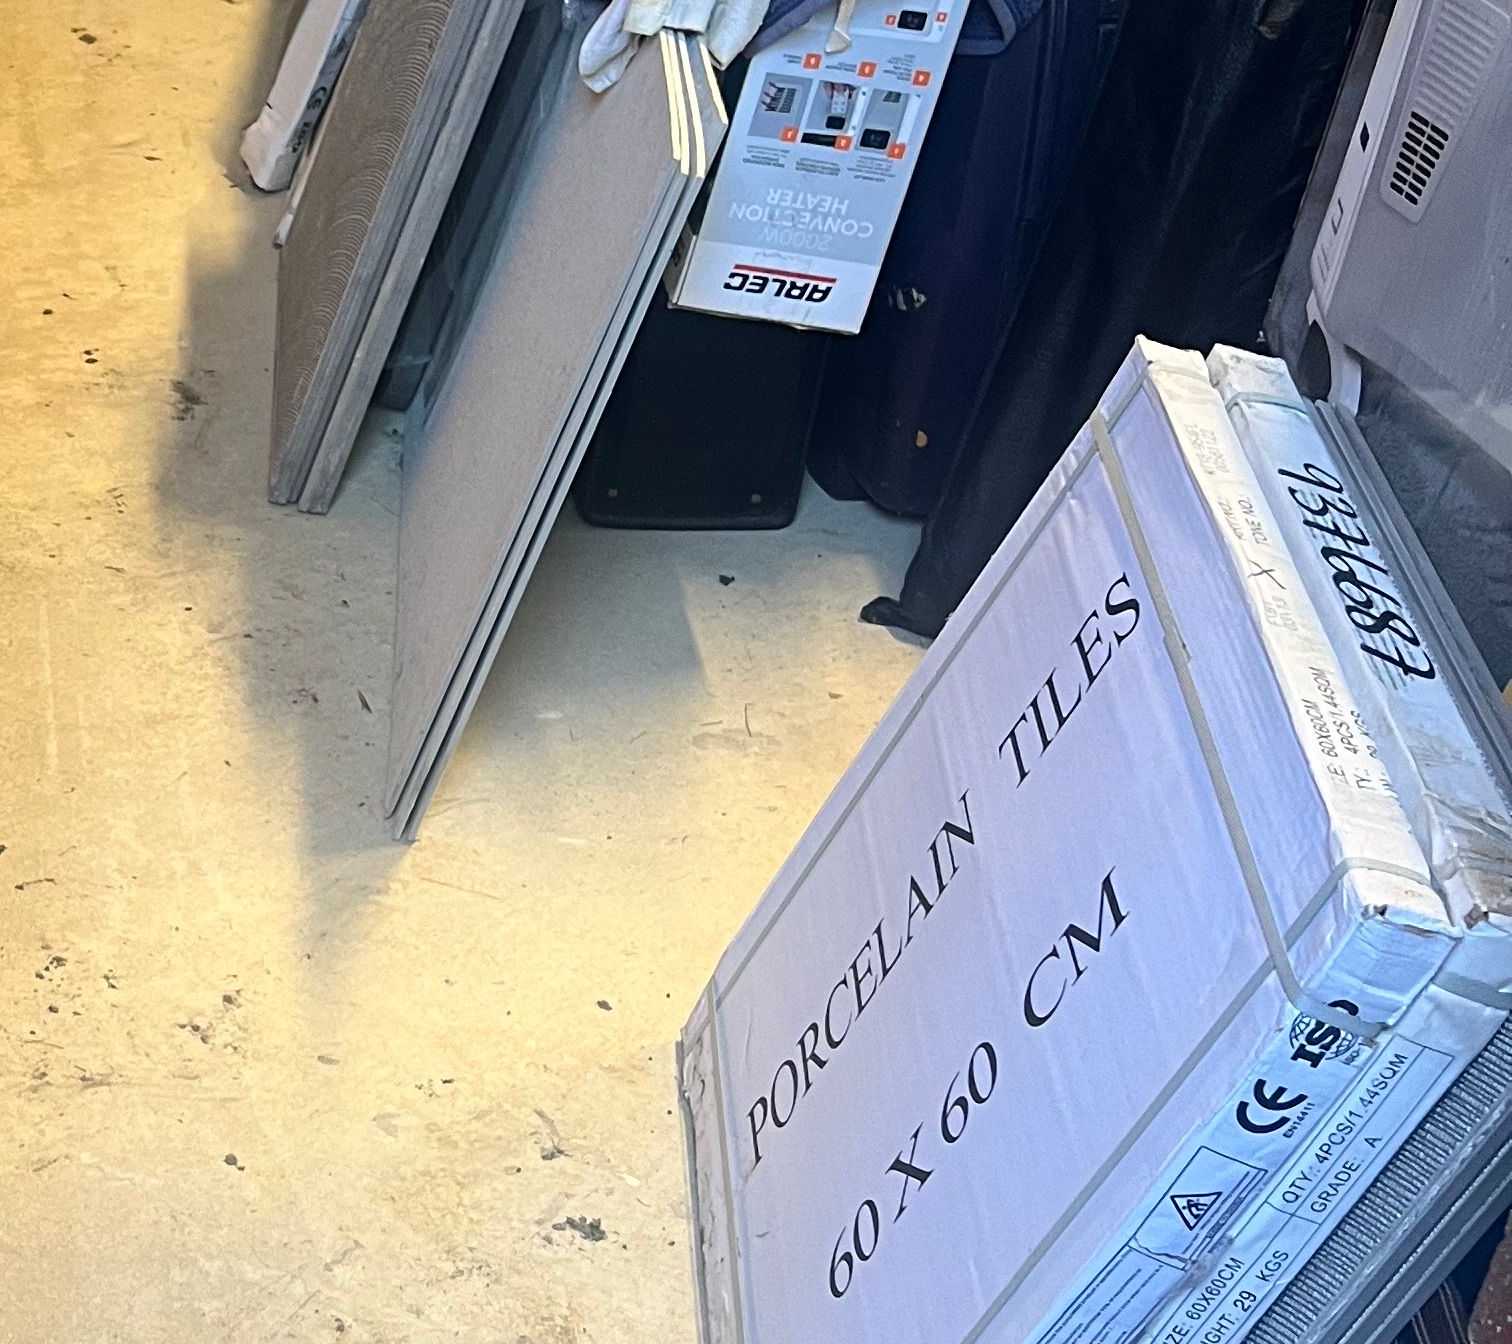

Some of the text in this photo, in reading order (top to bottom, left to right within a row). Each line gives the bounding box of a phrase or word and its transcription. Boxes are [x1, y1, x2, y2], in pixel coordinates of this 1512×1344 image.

[728, 203, 874, 238] CONVECTION
[767, 188, 849, 216] HEATER
[761, 226, 833, 252] 2000W
[723, 272, 833, 303] ARLEC
[1278, 462, 1437, 680] 9376687
[1301, 698, 1339, 758] 60X60CM
[746, 571, 1140, 1173] PORCELAIN TILES
[829, 864, 1131, 1299] 60 X 60 CM
[1236, 1078, 1309, 1134] CE
[1315, 1053, 1409, 1165] 4PCS/1.44SQM
[1364, 1136, 1383, 1149] A
[1185, 1256, 1246, 1321] 60X60CM
[1233, 1290, 1257, 1312] 29
[1255, 1250, 1289, 1283] KGS
